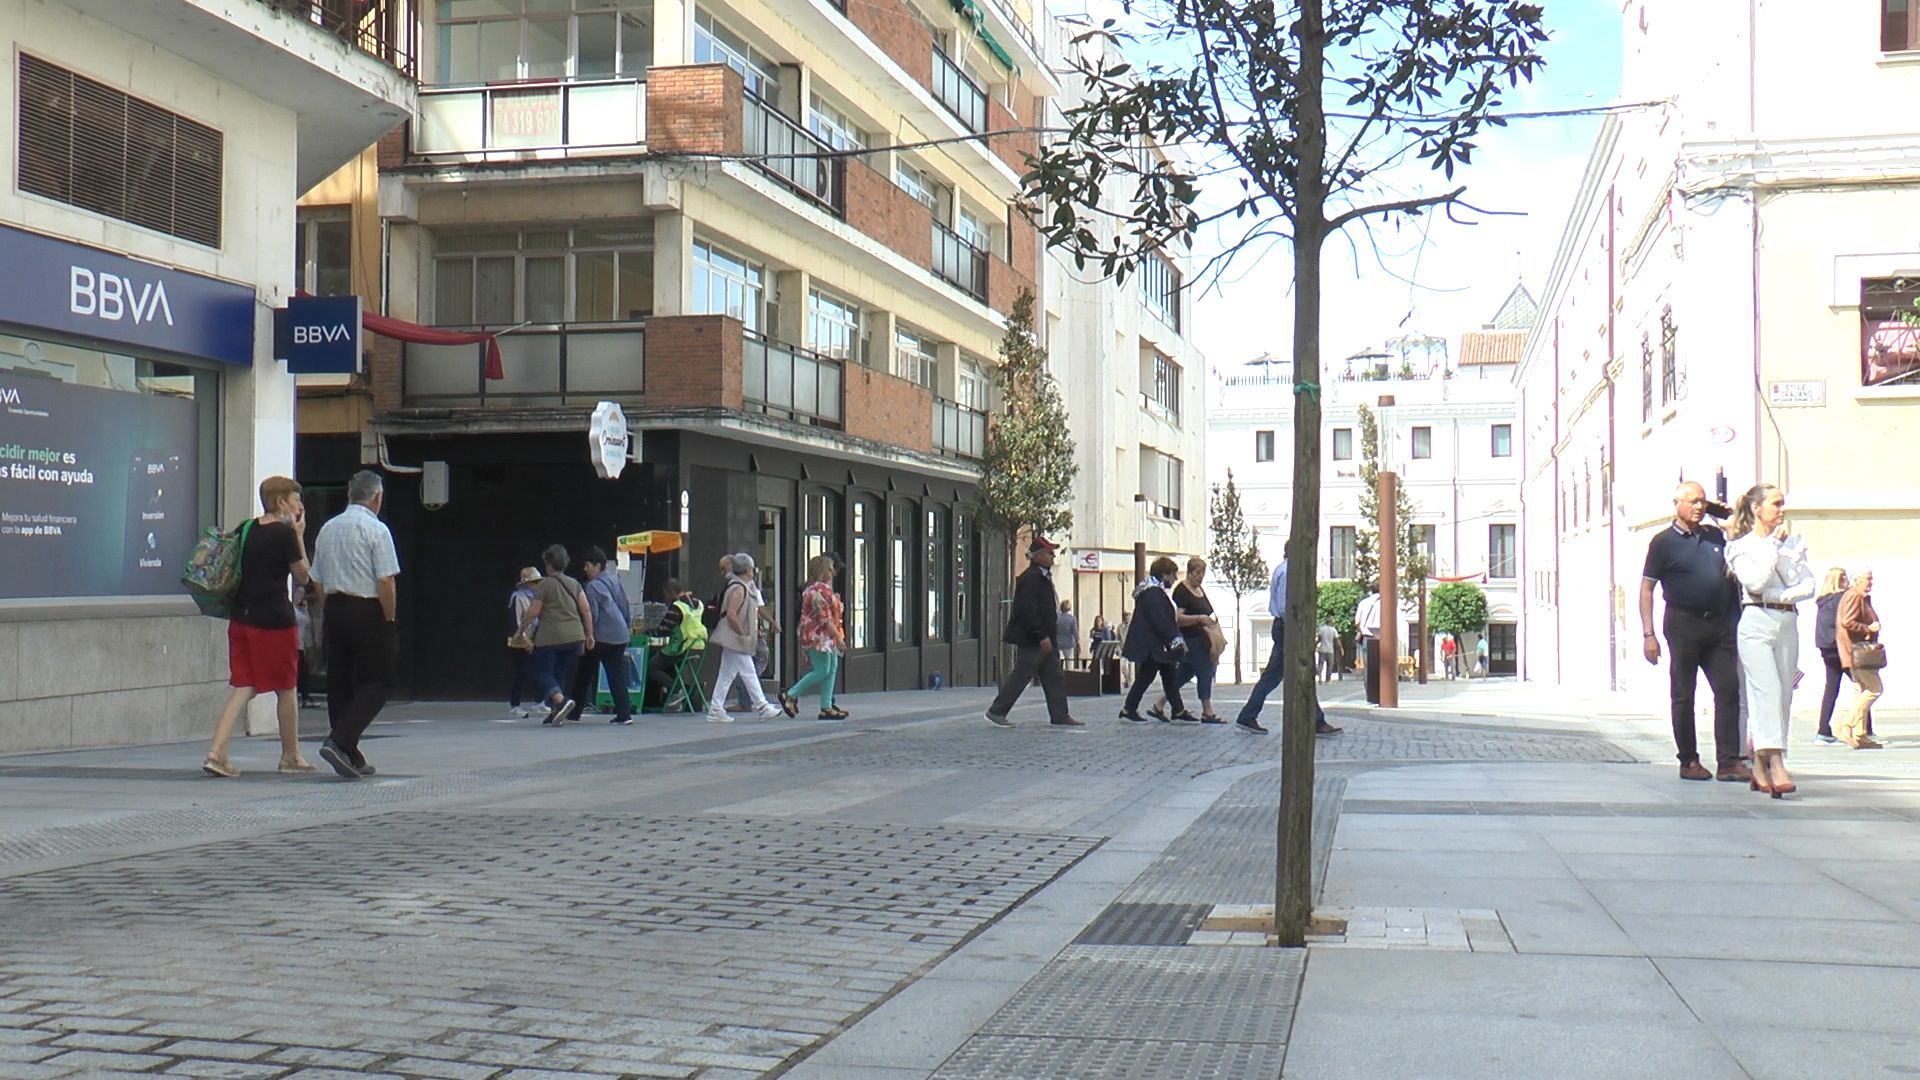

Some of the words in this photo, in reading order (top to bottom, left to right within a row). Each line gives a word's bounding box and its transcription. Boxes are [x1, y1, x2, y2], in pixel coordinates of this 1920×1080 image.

[69, 265, 174, 326] BBVA
[294, 323, 351, 344] BBVA
[0, 387, 21, 405] VA
[28, 447, 61, 465] mejor
[63, 452, 76, 464] es
[11, 463, 36, 480] fácil
[38, 468, 59, 482] con
[61, 469, 94, 486] ayuda
[147, 463, 165, 474] BBVA
[2, 512, 24, 524] Mejora
[1, 526, 14, 534] con
[21, 526, 34, 537] app
[35, 525, 43, 535] de
[44, 525, 62, 536] BBVA
[139, 557, 162, 568] Vivienda
